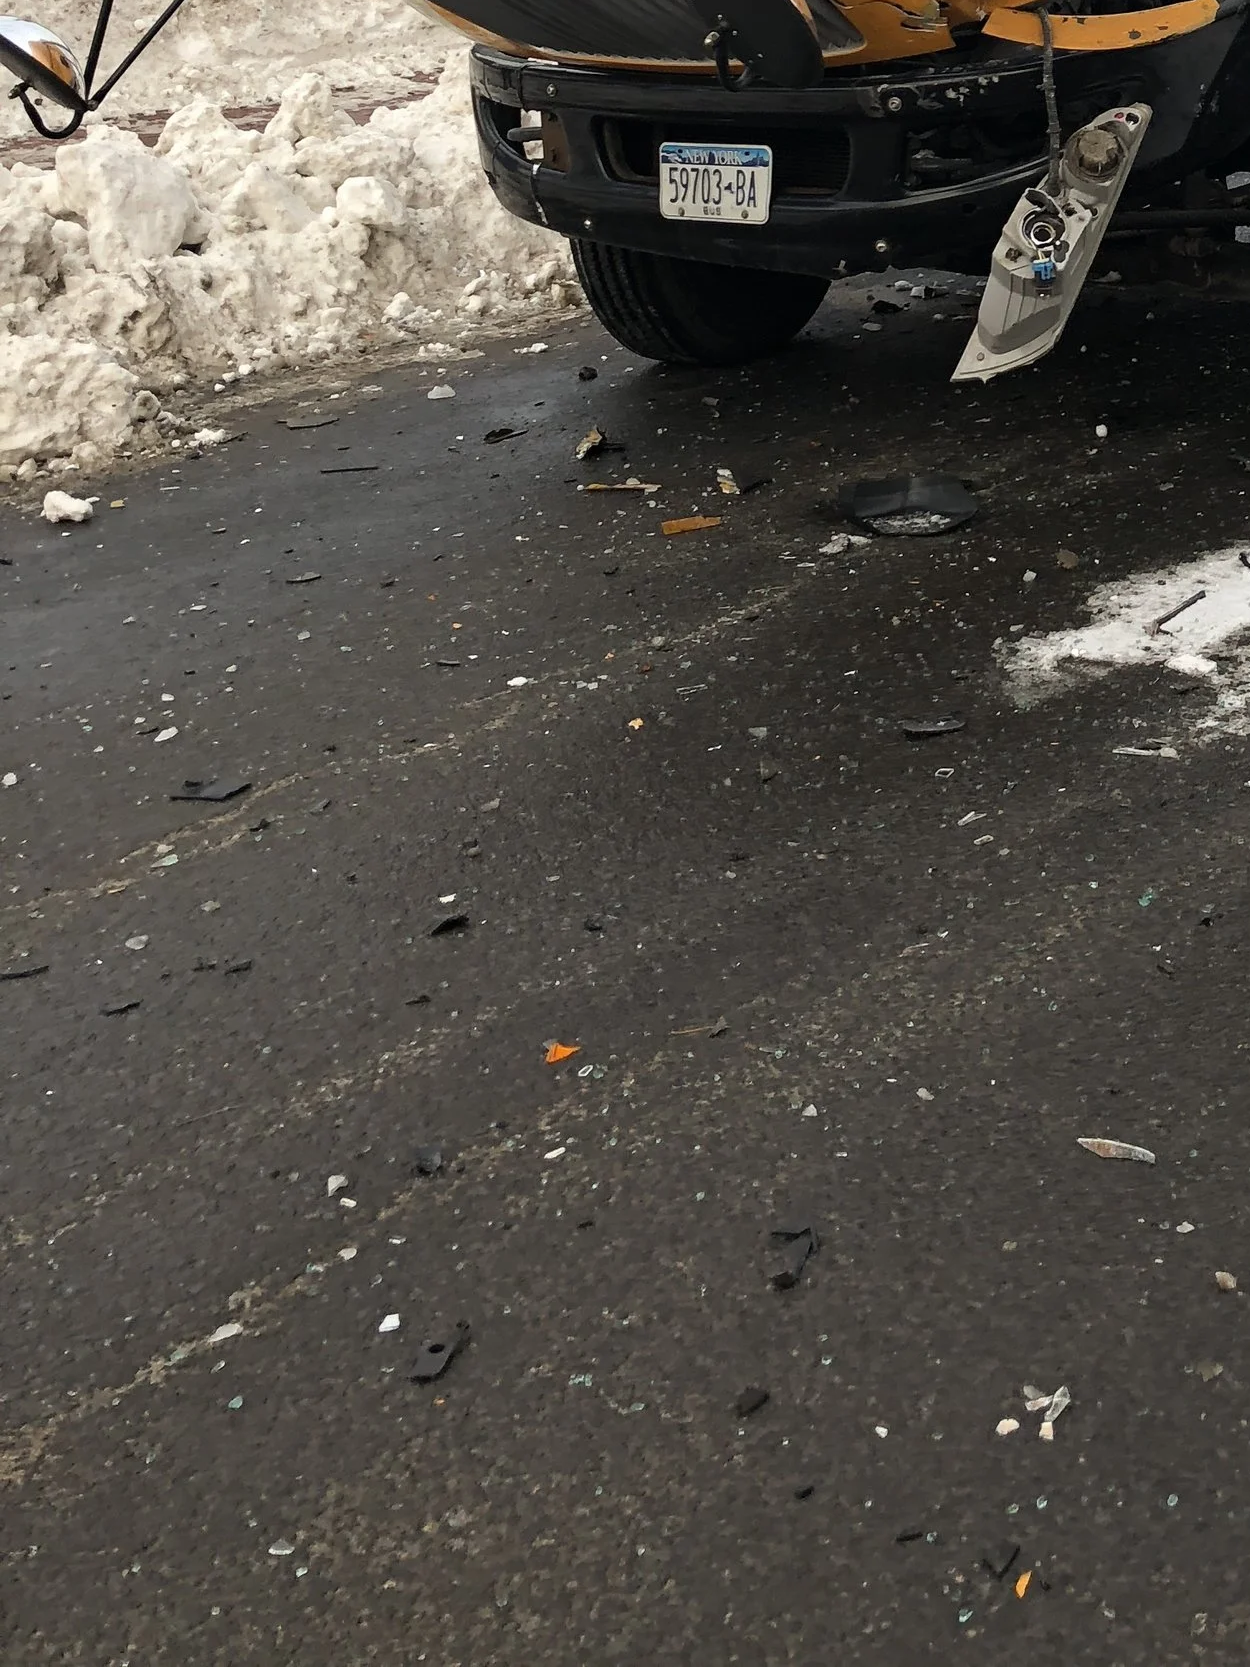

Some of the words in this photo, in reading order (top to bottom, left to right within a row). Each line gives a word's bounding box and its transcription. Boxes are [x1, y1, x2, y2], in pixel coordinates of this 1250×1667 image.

[685, 149, 711, 164] NEW
[712, 149, 744, 166] YORK
[702, 205, 722, 216] BUS
